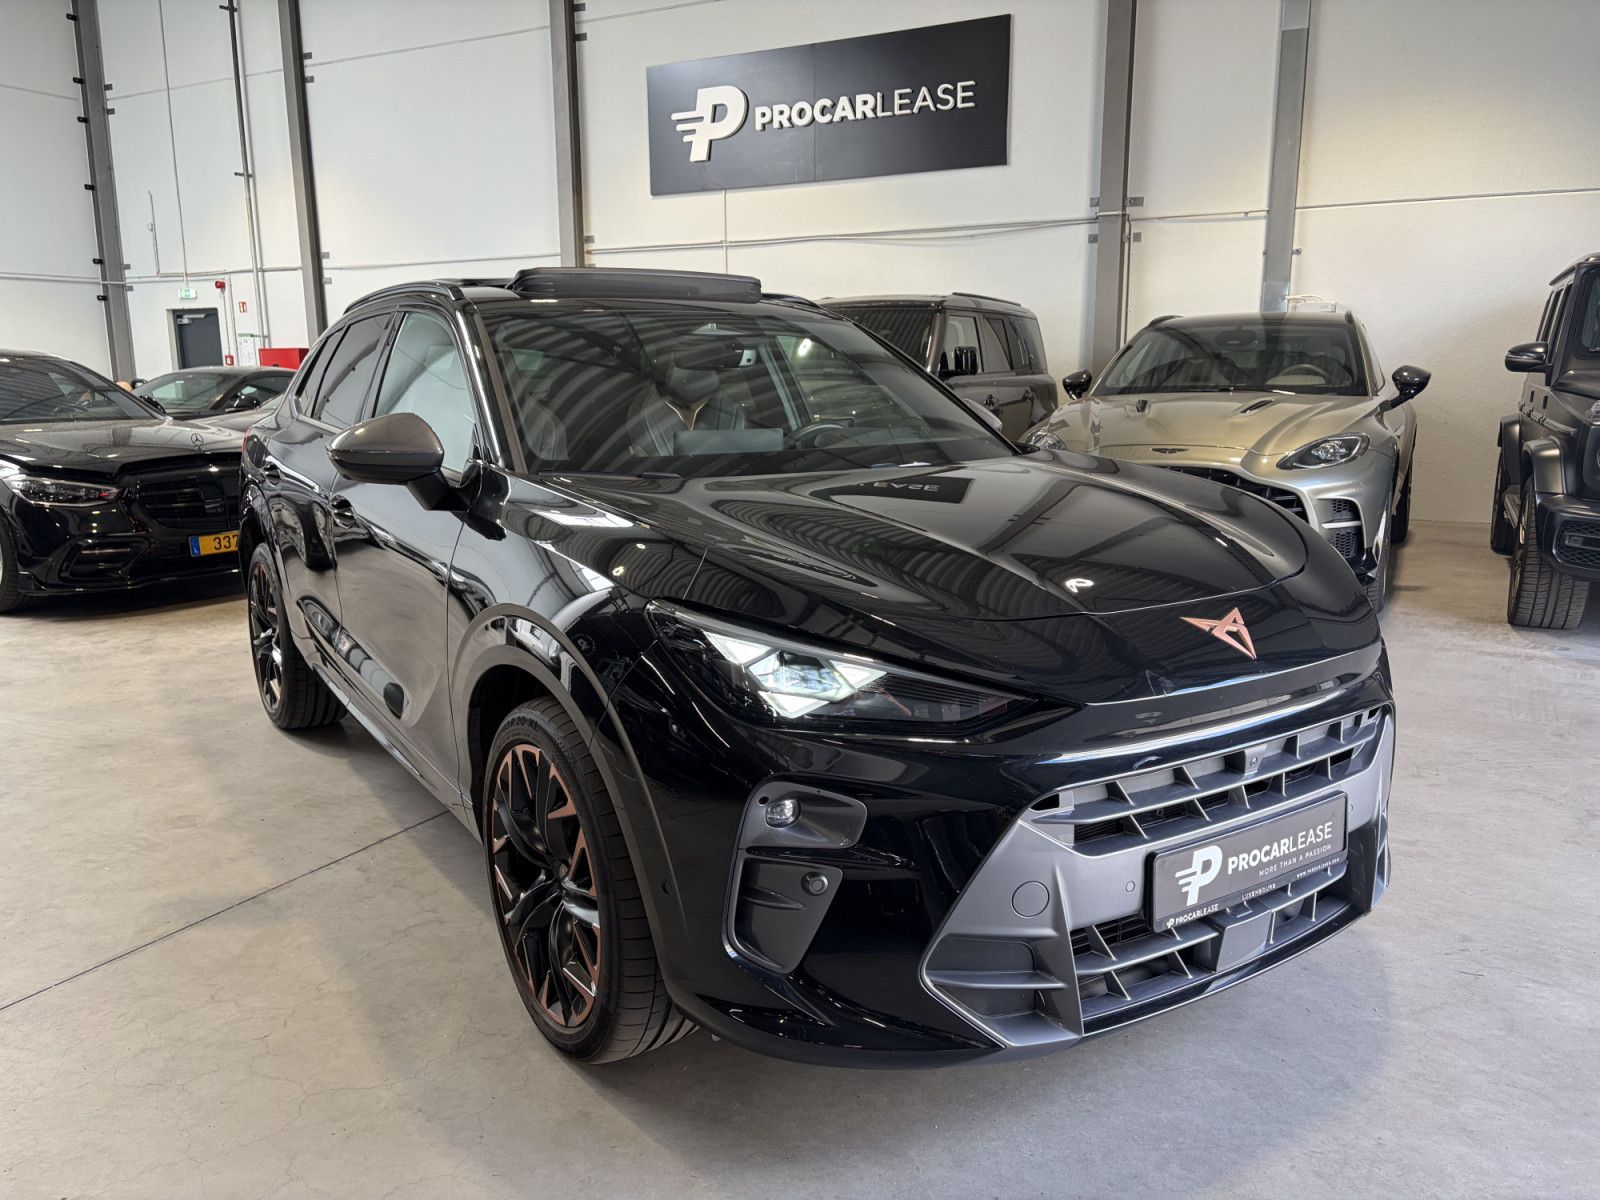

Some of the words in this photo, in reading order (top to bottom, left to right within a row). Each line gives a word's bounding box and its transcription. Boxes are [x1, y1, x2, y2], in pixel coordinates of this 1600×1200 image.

[755, 80, 976, 131] PROCARLEASE
[1227, 821, 1333, 875] PROCARLEASE
[1258, 863, 1278, 877] MORE
[1280, 857, 1297, 869] THAN
[1305, 843, 1332, 859] PASSION
[1175, 903, 1219, 925] PROCARLEASE
